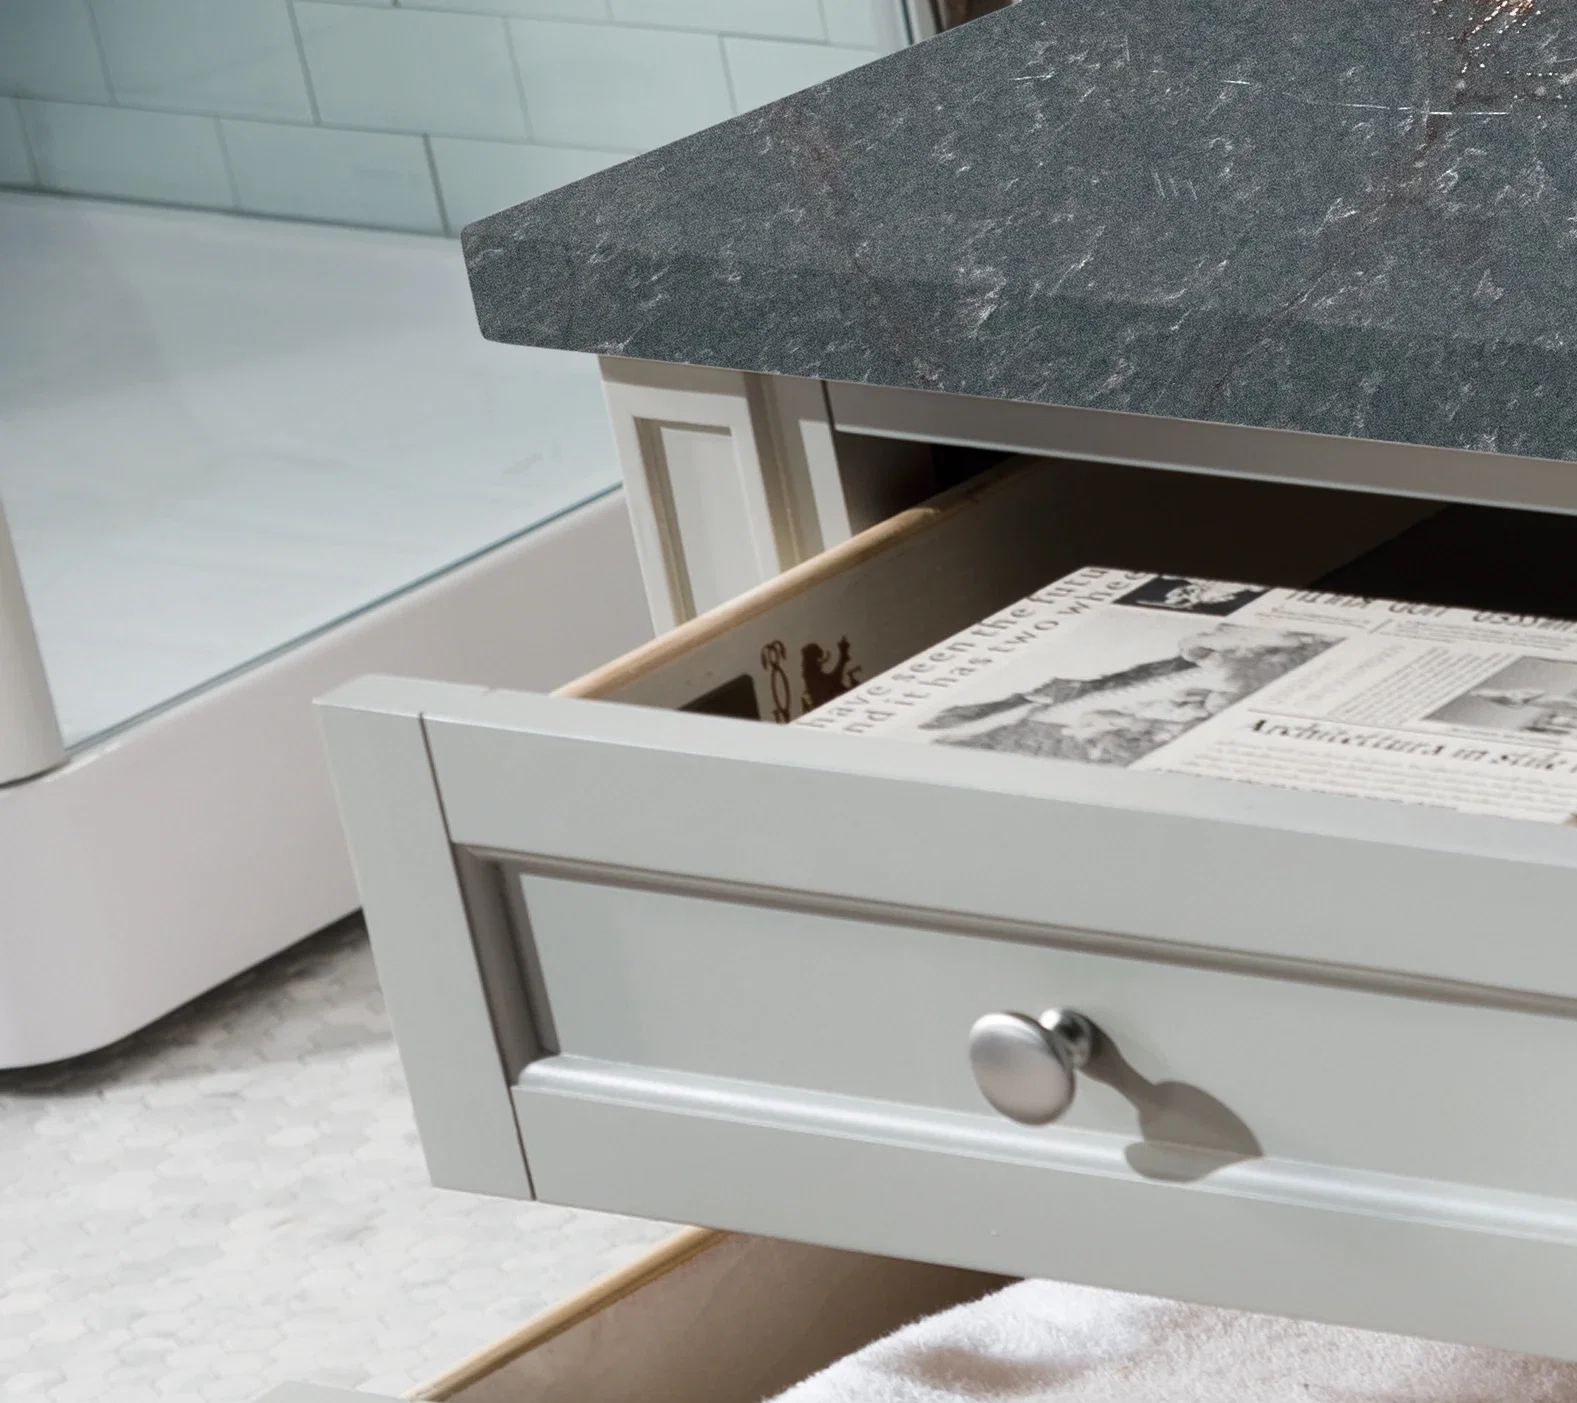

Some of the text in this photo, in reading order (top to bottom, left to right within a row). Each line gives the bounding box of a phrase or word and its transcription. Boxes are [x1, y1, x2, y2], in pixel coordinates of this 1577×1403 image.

[795, 682, 893, 730] have
[891, 639, 976, 683] seen
[970, 604, 1038, 642] the
[894, 689, 932, 707] it
[916, 654, 994, 689] has
[987, 617, 1061, 654] two
